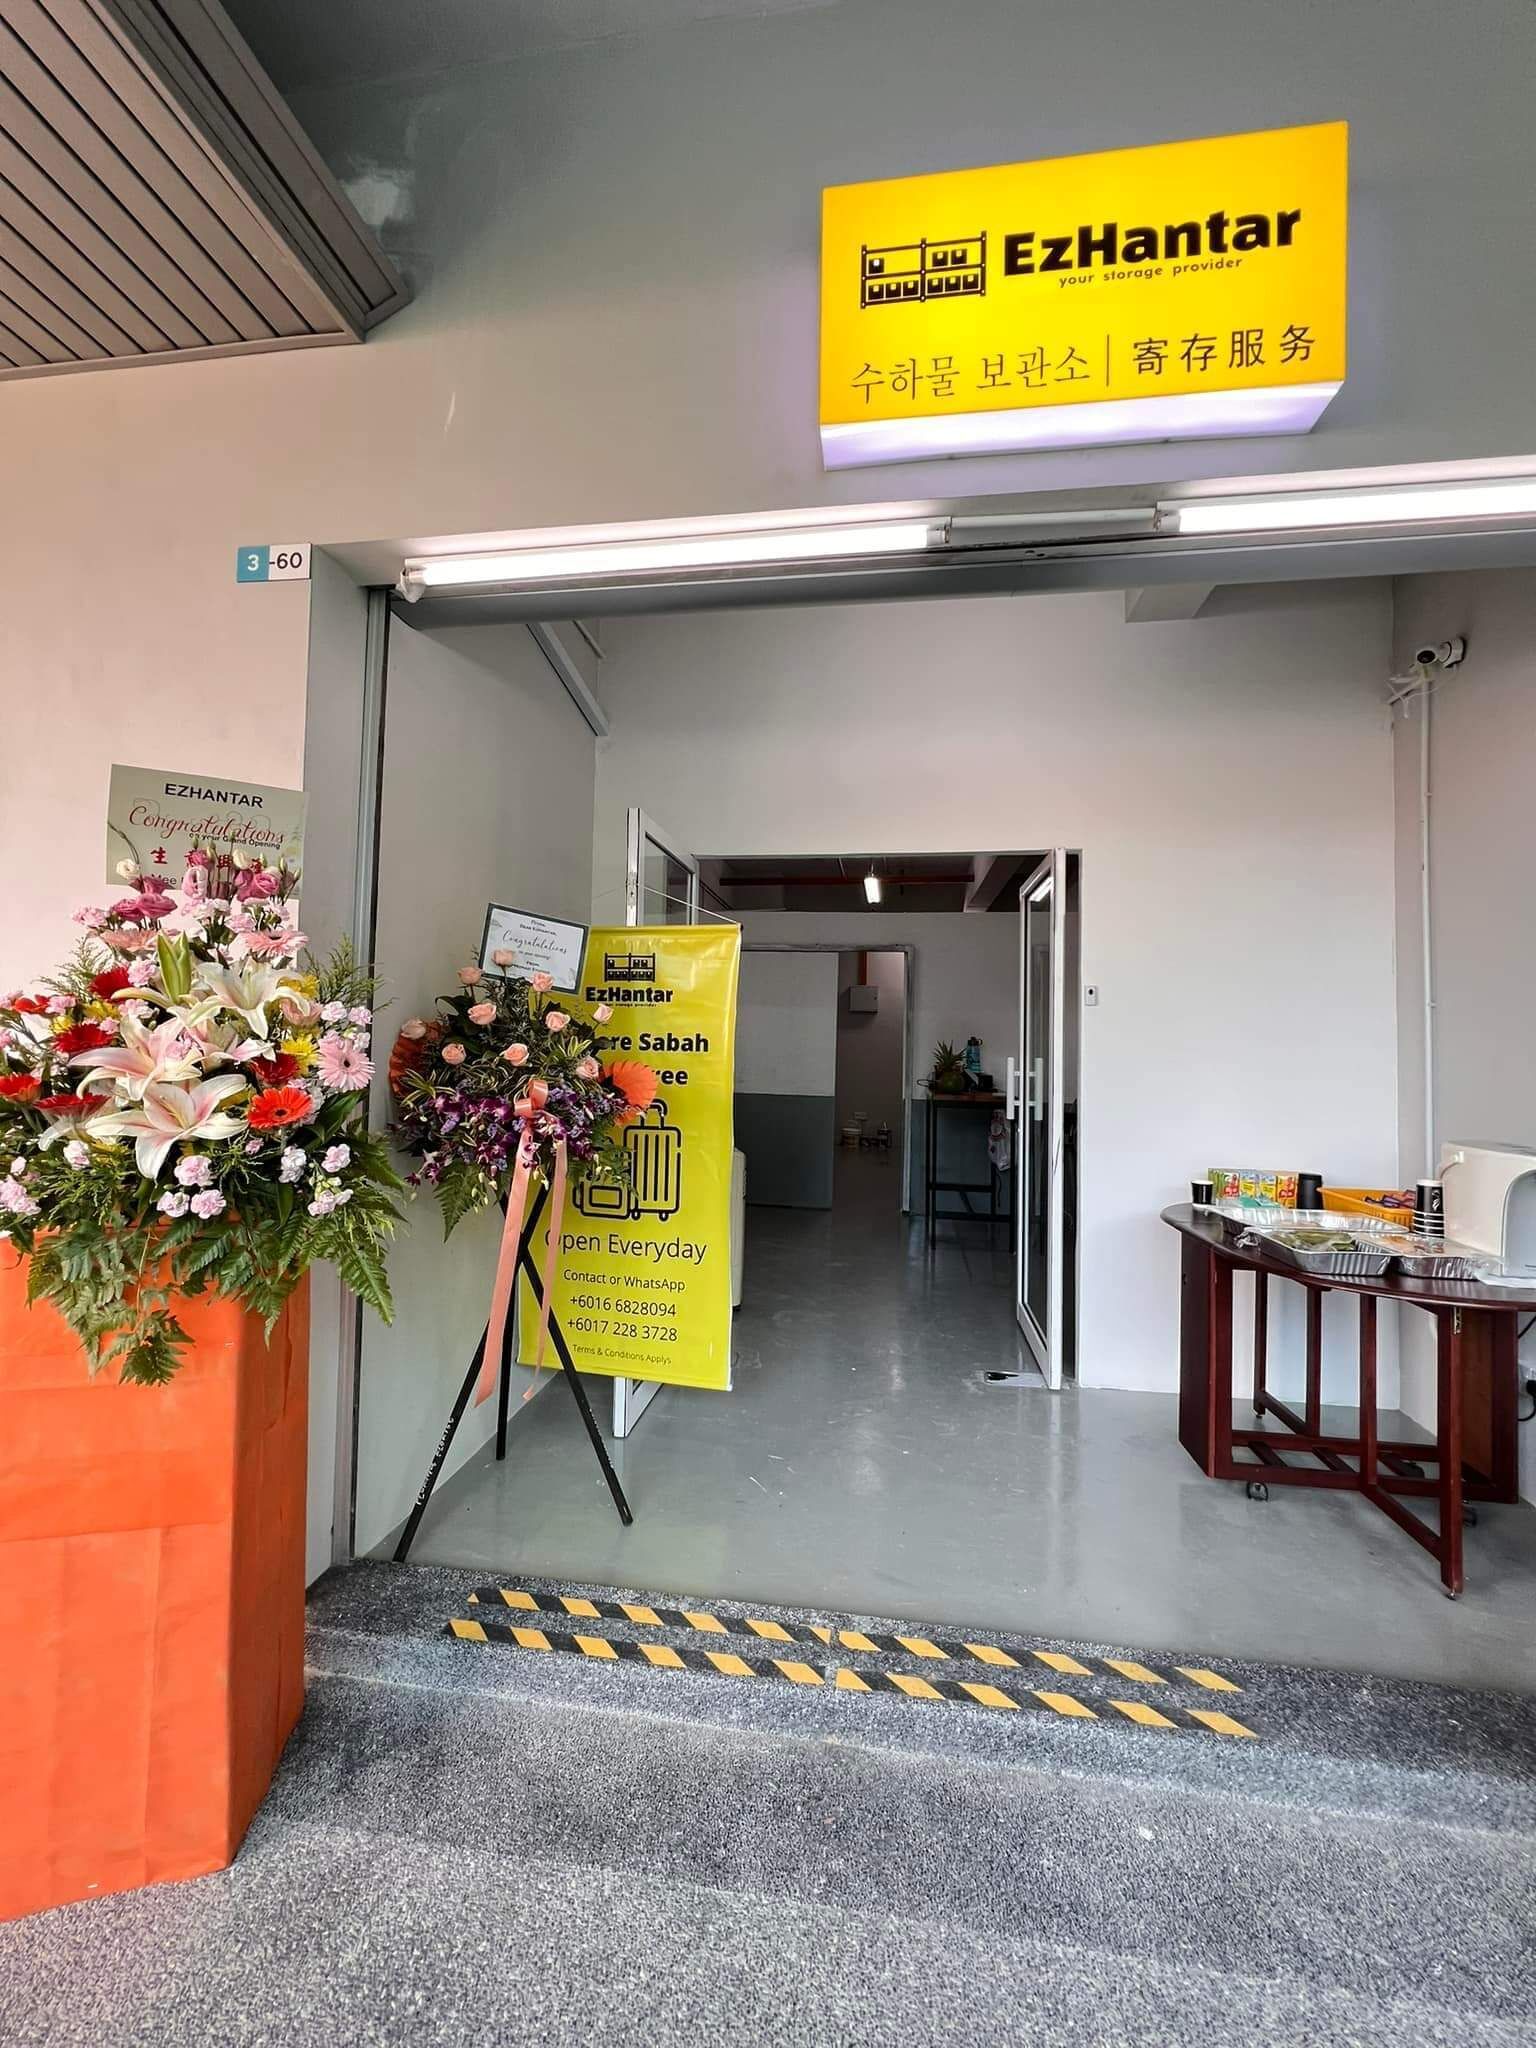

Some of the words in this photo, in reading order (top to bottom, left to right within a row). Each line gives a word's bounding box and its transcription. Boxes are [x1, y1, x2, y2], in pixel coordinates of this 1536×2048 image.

[1003, 208, 1302, 277] EzHantar
[1059, 270, 1095, 287] your
[1103, 265, 1164, 283] storage
[1173, 256, 1243, 277] provider
[1132, 324, 1316, 375] 寄存服务
[850, 355, 960, 404] 수하물
[976, 346, 1091, 390] 보관소
[164, 783, 264, 808] EZHANTAR
[129, 806, 284, 844] Congratulations
[222, 835, 247, 844] Gand
[249, 838, 281, 850] Opening
[586, 986, 674, 1003] EzHantar
[638, 1032, 709, 1052] Sabah
[608, 1233, 708, 1266] Everyday
[563, 1269, 607, 1285] Contact
[609, 1275, 622, 1285] or
[623, 1275, 686, 1293] WhatsApp
[569, 1294, 612, 1311] +6016
[615, 1298, 677, 1317] 6828094
[567, 1317, 609, 1334] +6017
[612, 1321, 638, 1338] 228
[641, 1325, 678, 1342] 3728
[572, 1344, 596, 1355] Terms
[604, 1348, 645, 1361] Conditions
